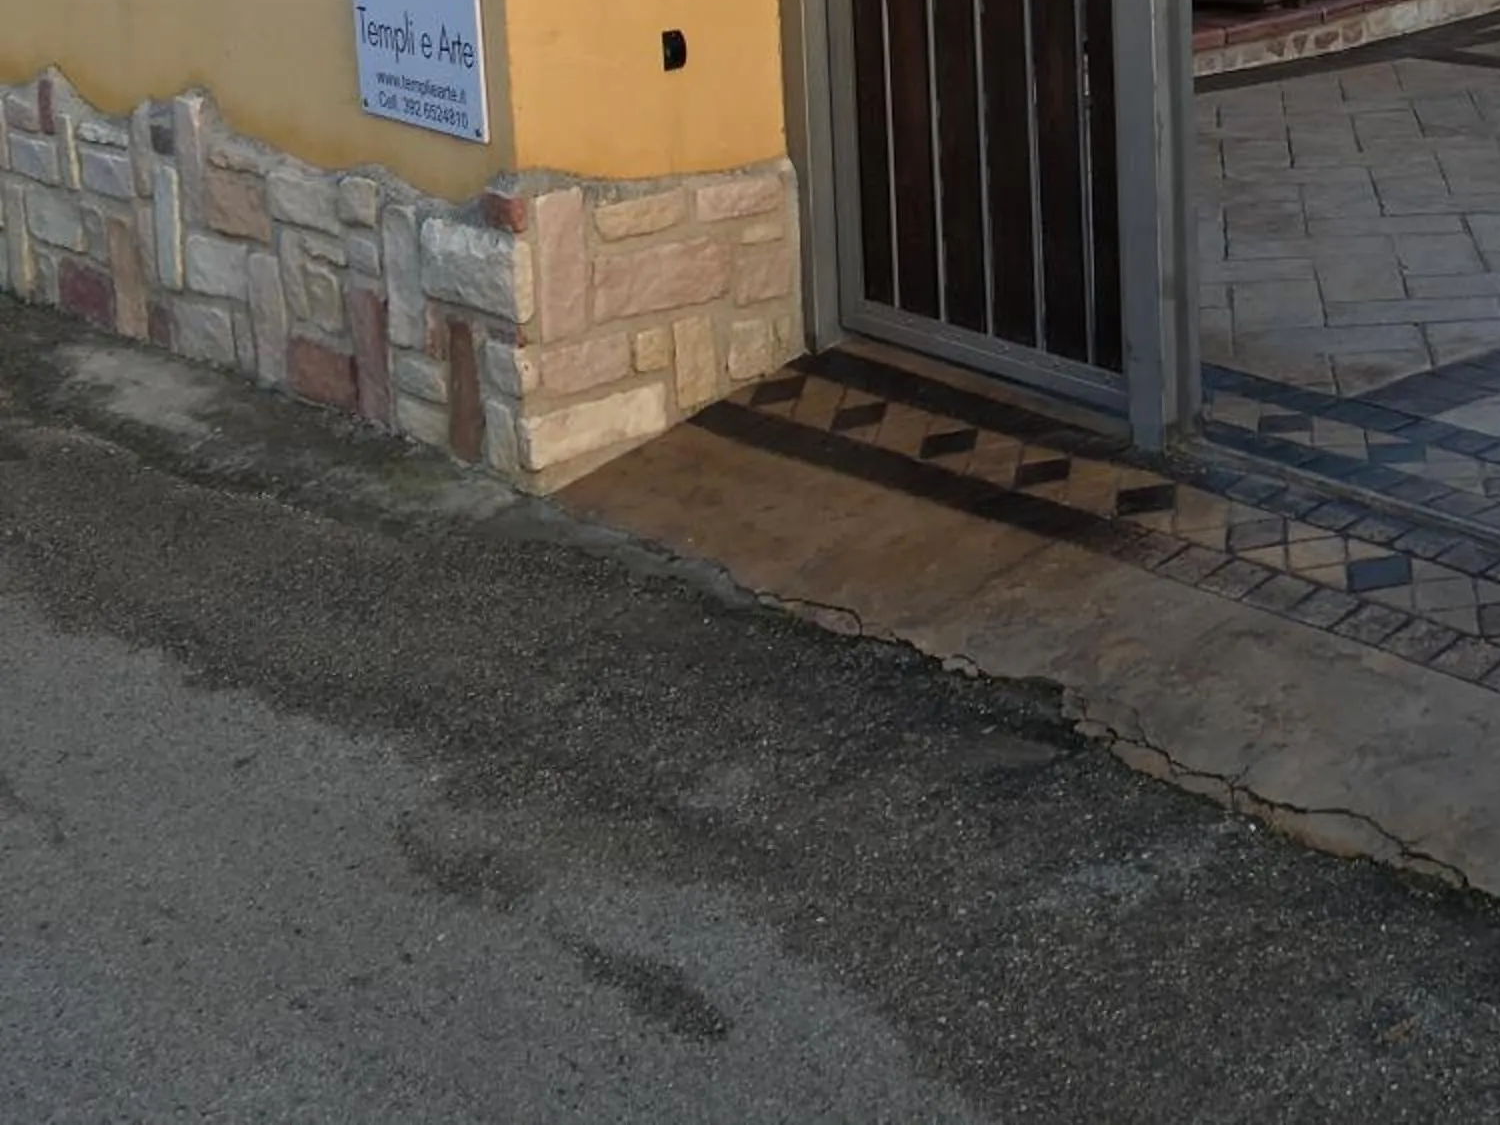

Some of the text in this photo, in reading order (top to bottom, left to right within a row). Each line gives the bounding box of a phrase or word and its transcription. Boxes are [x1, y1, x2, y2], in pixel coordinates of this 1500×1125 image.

[356, 6, 475, 68] Templi e Arte
